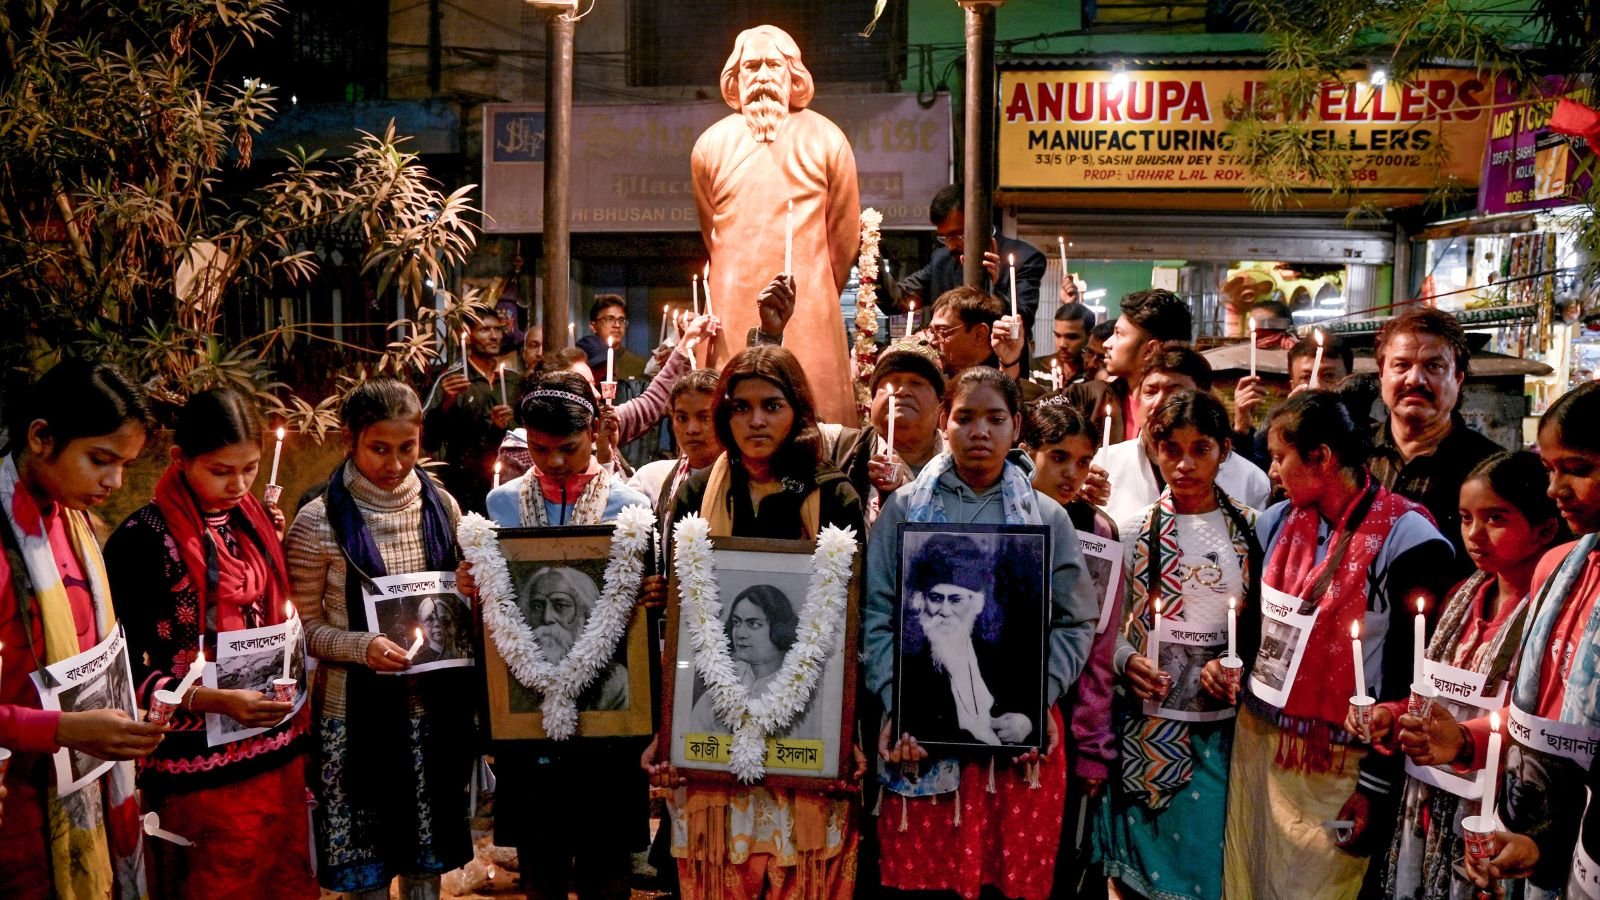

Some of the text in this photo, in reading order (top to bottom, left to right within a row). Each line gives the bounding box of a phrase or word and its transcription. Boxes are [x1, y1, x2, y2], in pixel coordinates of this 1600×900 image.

[1006, 80, 1212, 123] ANURUPA
[1492, 108, 1526, 140] MISI
[1028, 130, 1234, 151] MANUFACTURING
[1035, 154, 1063, 166] 33/5
[1098, 154, 1133, 166] SASHI
[1135, 155, 1184, 166] BHUSAN
[1187, 155, 1213, 166] DEY
[1127, 169, 1175, 181] JAHAR
[1178, 169, 1209, 181] LAL
[593, 207, 665, 221] BHUSAN
[671, 207, 695, 221] DE
[1170, 629, 1218, 642] বাংলাদেশের
[690, 736, 720, 758] কাজী
[776, 740, 818, 763] ইসলাম
